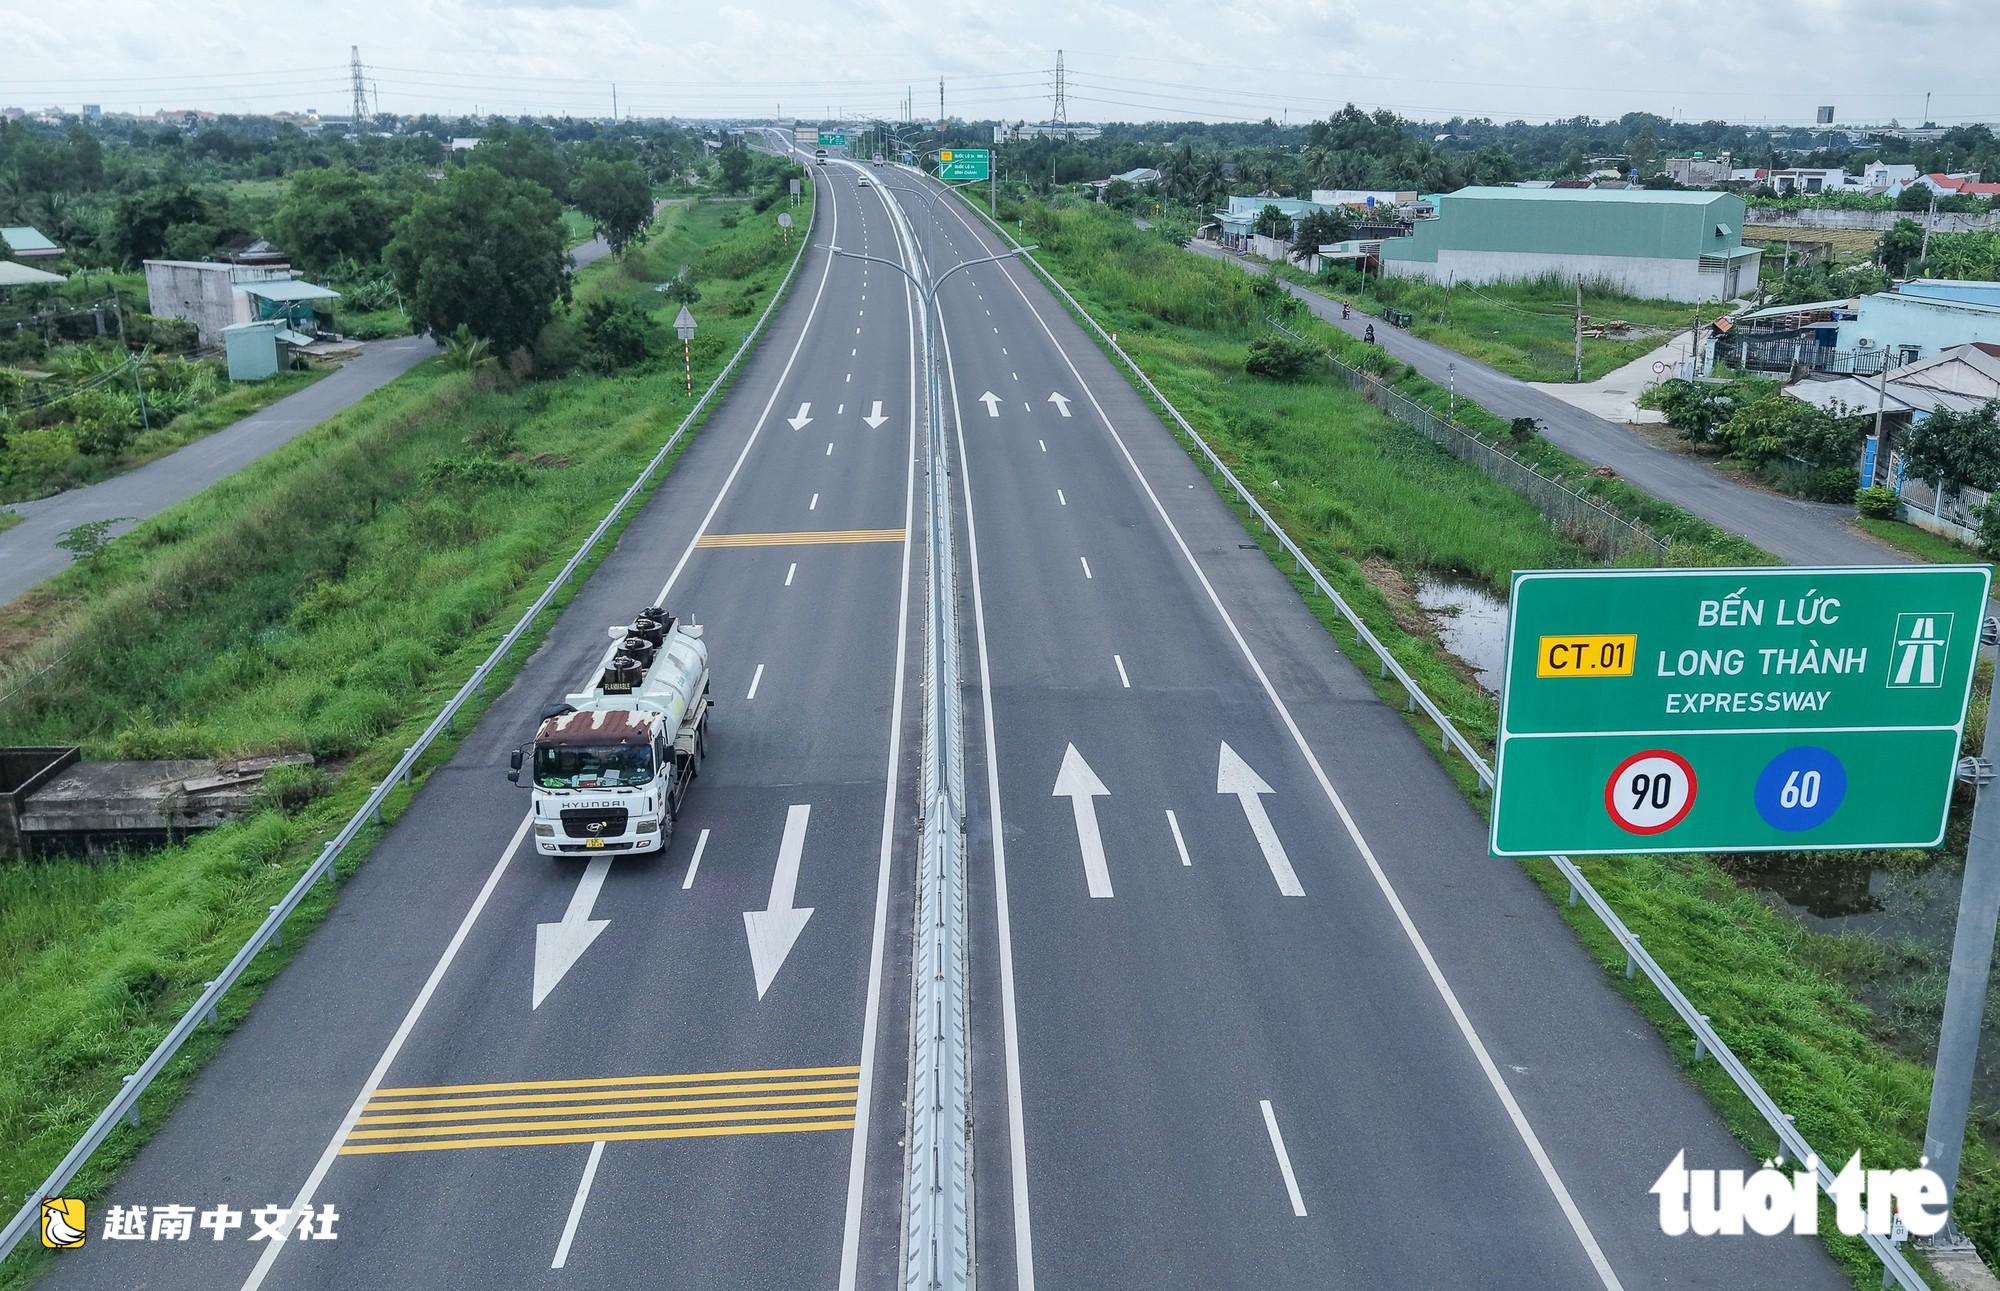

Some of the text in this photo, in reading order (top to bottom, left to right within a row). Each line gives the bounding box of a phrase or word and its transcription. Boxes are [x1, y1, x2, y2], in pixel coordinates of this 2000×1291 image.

[1698, 587, 1841, 627] BẾN LỨC
[1549, 642, 1625, 669] CT.01
[1657, 639, 1867, 677] LONG THÀNH
[1665, 691, 1831, 713] EXPRESSWAY
[1632, 773, 1671, 810] 90
[1780, 770, 1821, 809] 60
